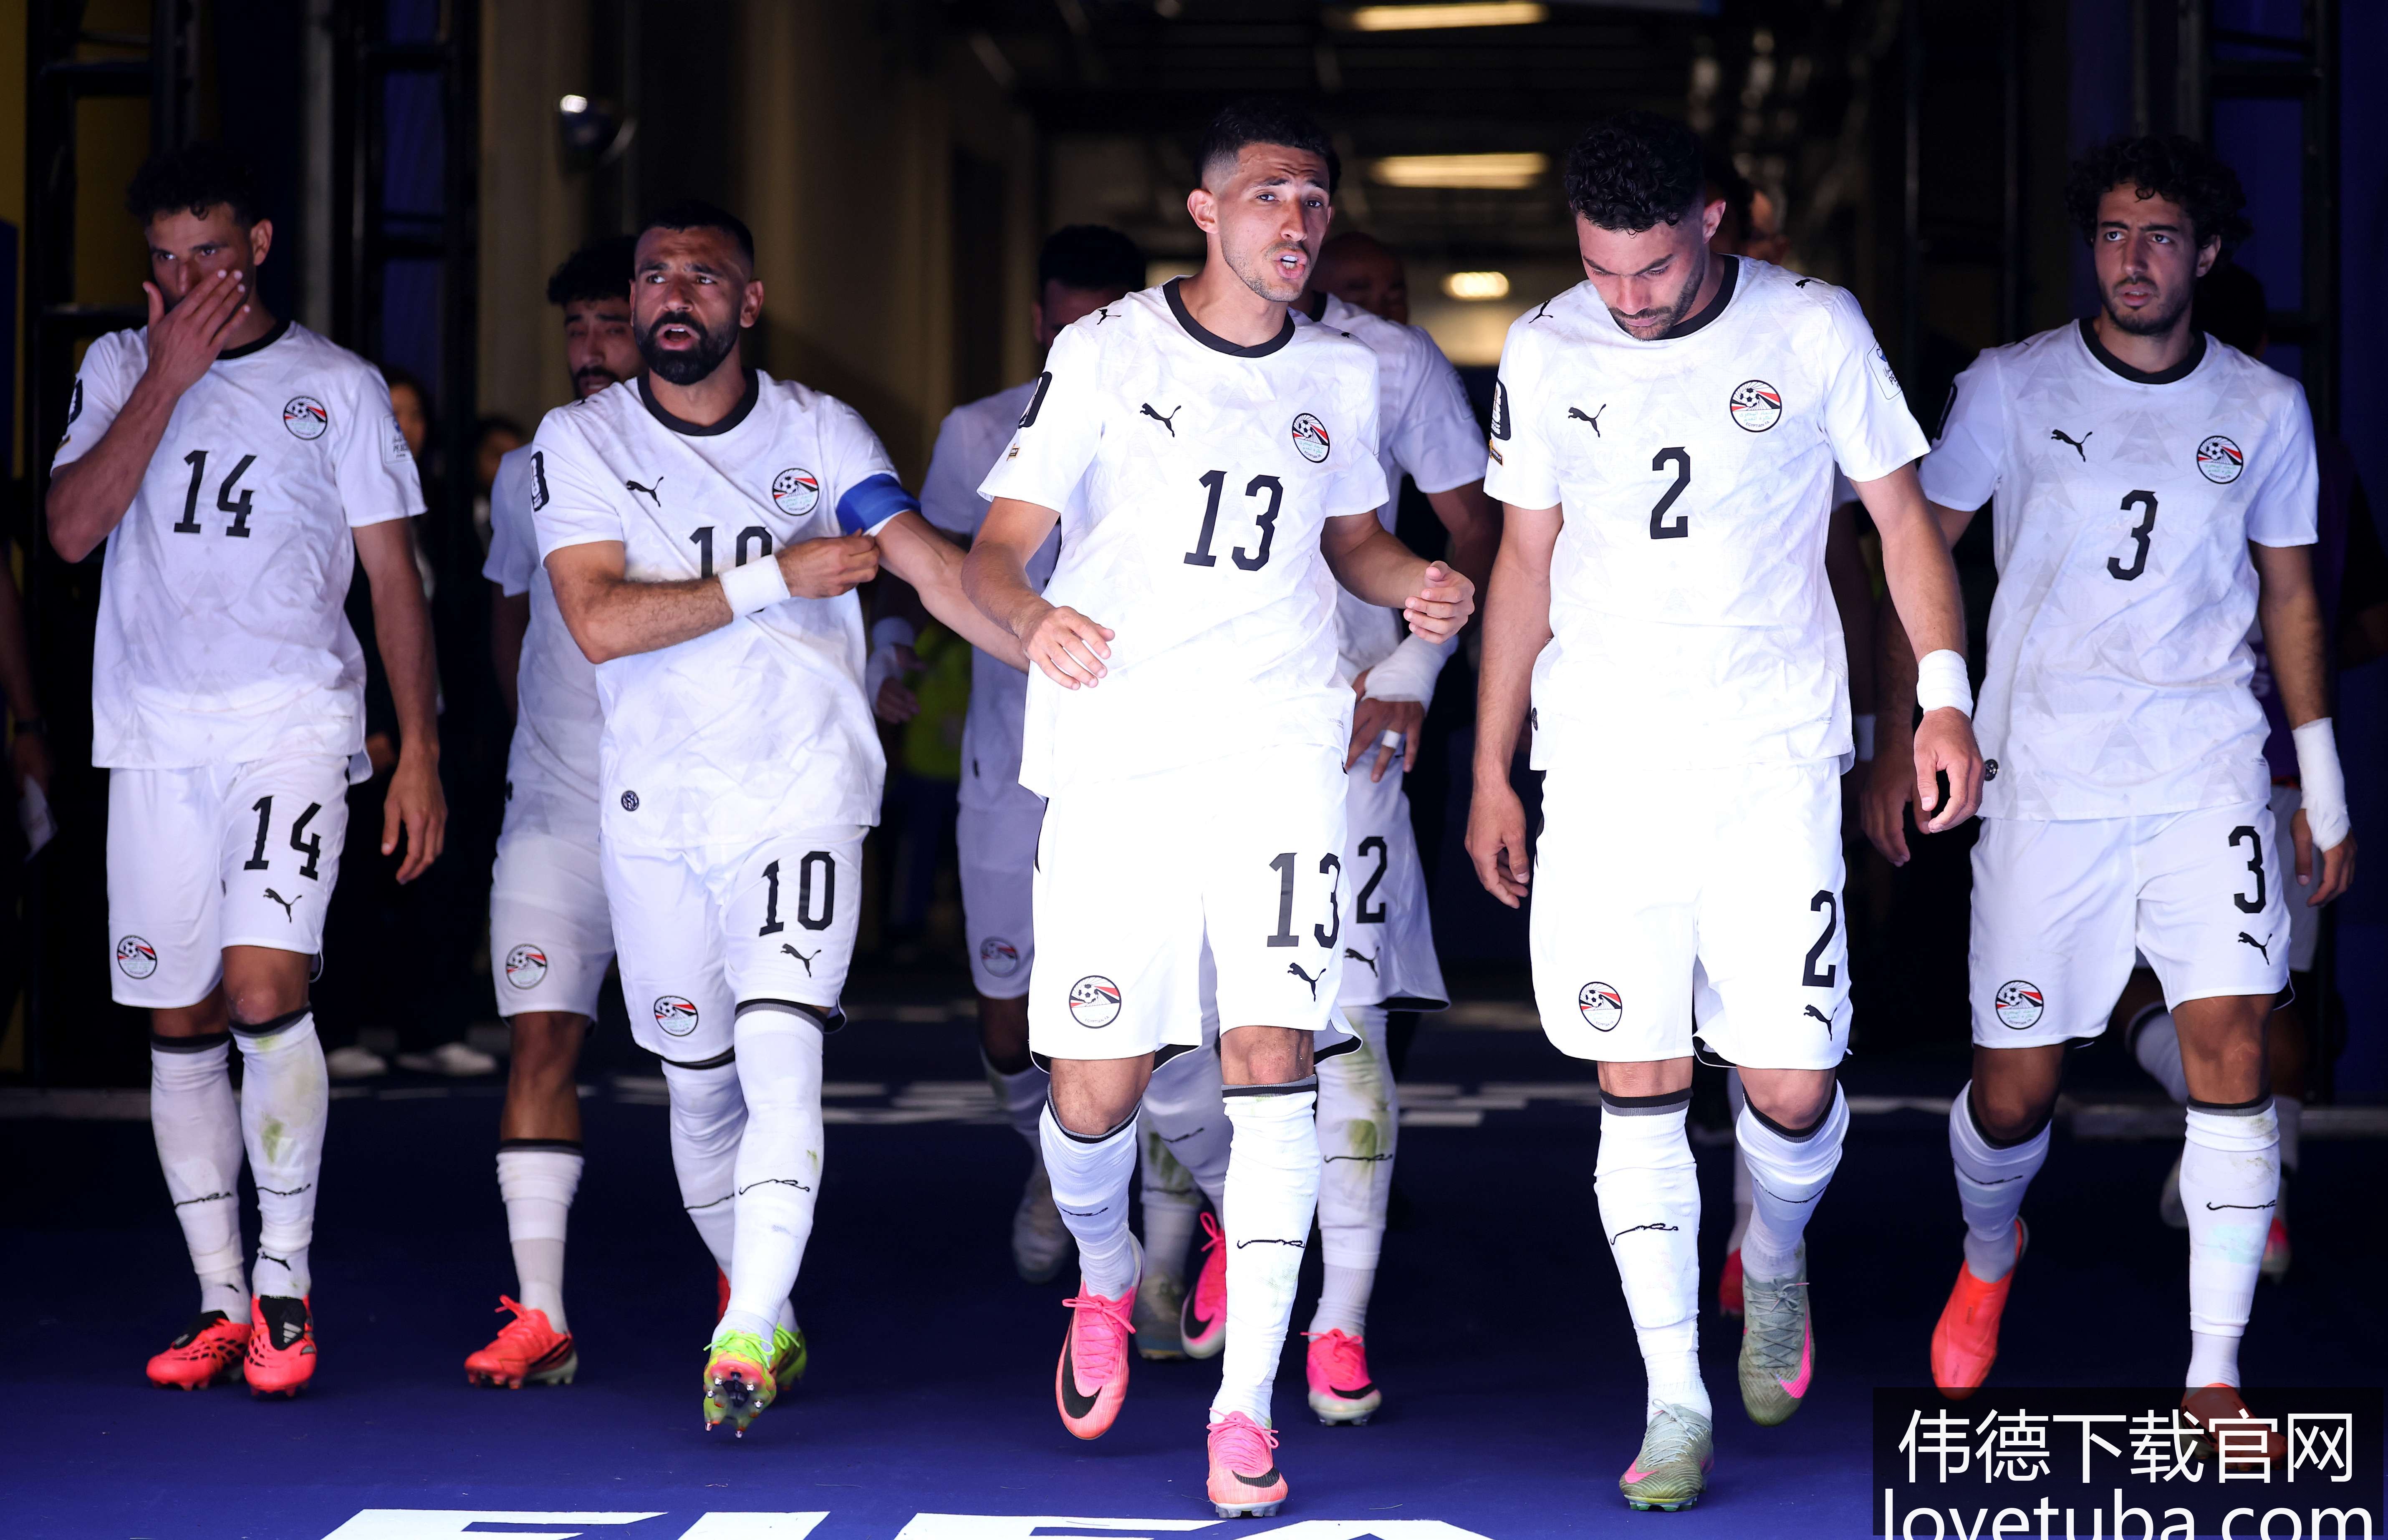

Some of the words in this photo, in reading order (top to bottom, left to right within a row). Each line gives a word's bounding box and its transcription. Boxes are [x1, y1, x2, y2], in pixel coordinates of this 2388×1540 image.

[174, 451, 256, 537] 14
[1184, 470, 1283, 571] 13
[1650, 447, 1690, 539] 2
[2108, 490, 2158, 580] 3
[244, 796, 321, 881] 14
[1357, 837, 1387, 923] 2
[2229, 826, 2266, 913] 3
[760, 852, 835, 936] 10
[1267, 853, 1340, 948] 13
[1802, 890, 1836, 988] 2
